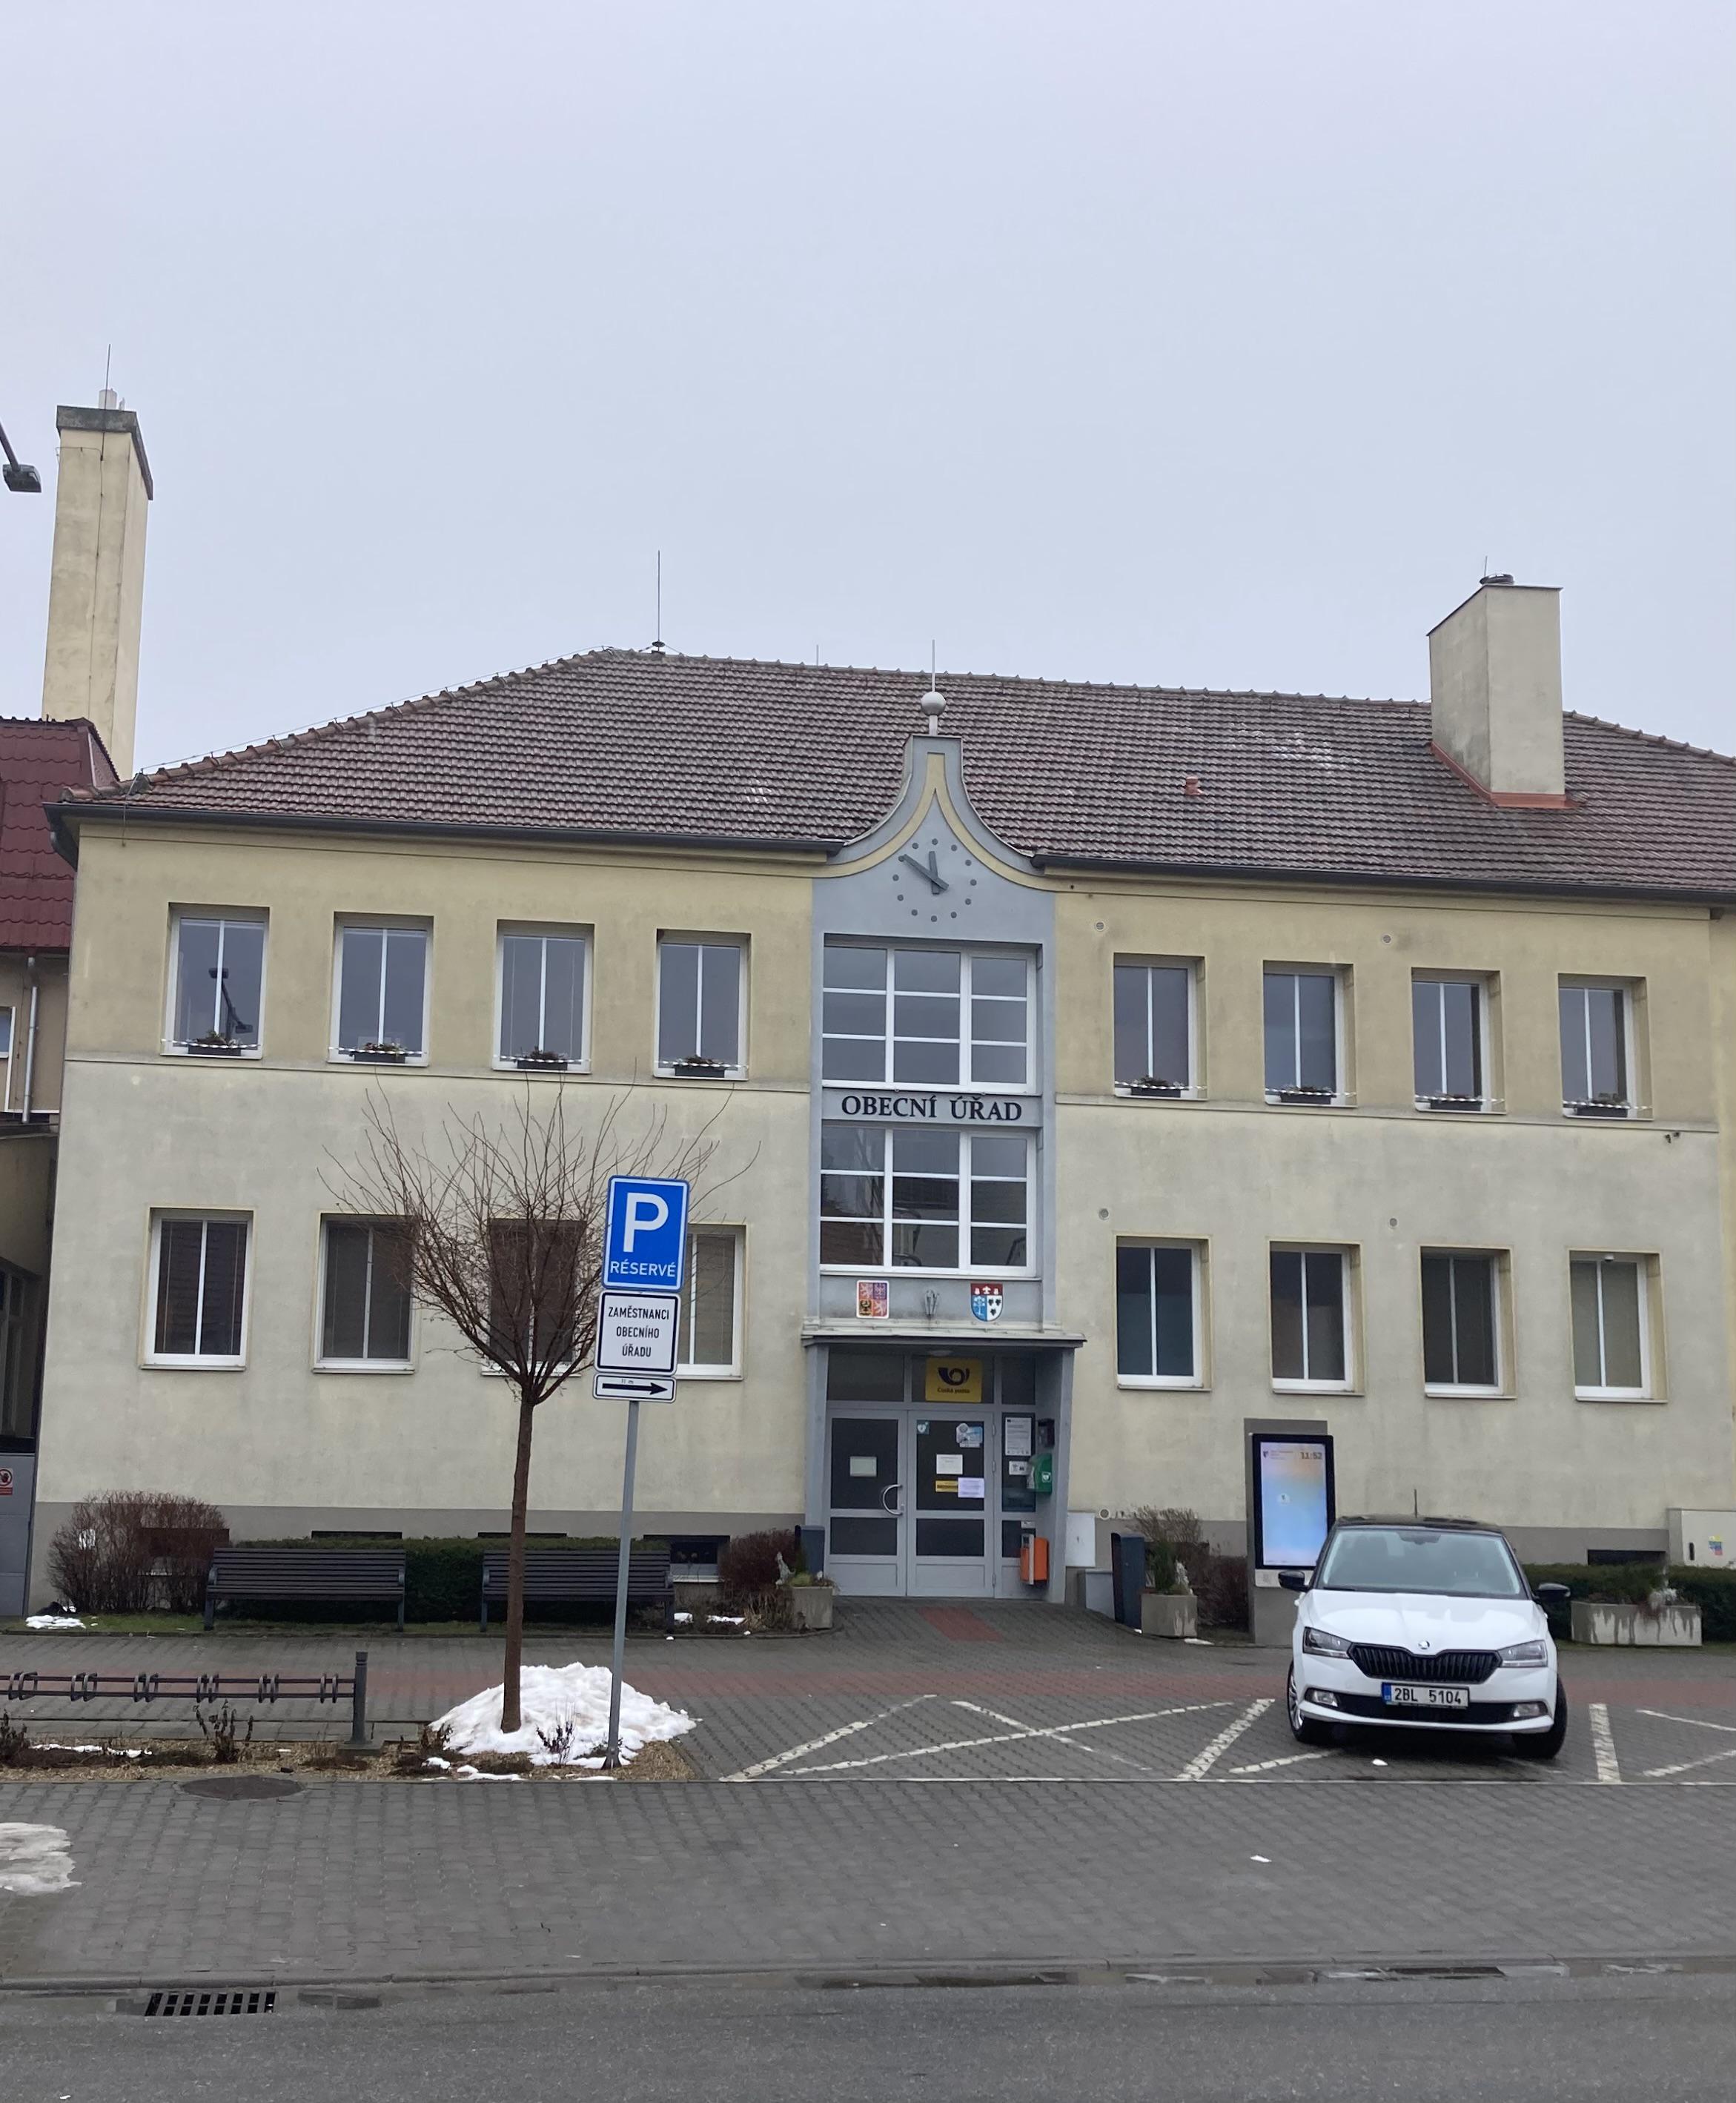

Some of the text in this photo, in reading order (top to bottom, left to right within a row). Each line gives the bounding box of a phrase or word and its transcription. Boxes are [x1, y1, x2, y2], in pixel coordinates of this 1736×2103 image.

[841, 1095, 1022, 1121] OBECNÍ ÚŘAD
[623, 1192, 669, 1253] P
[609, 1259, 676, 1278] RÉSERVÉ
[608, 1304, 670, 1320] ZAMĚSTNANCI
[616, 1325, 660, 1339] OBECNÍHO
[621, 1342, 652, 1358] ÚŘADU
[1300, 1451, 1323, 1460] 11:52
[1394, 1687, 1462, 1704] 2BL 5104
